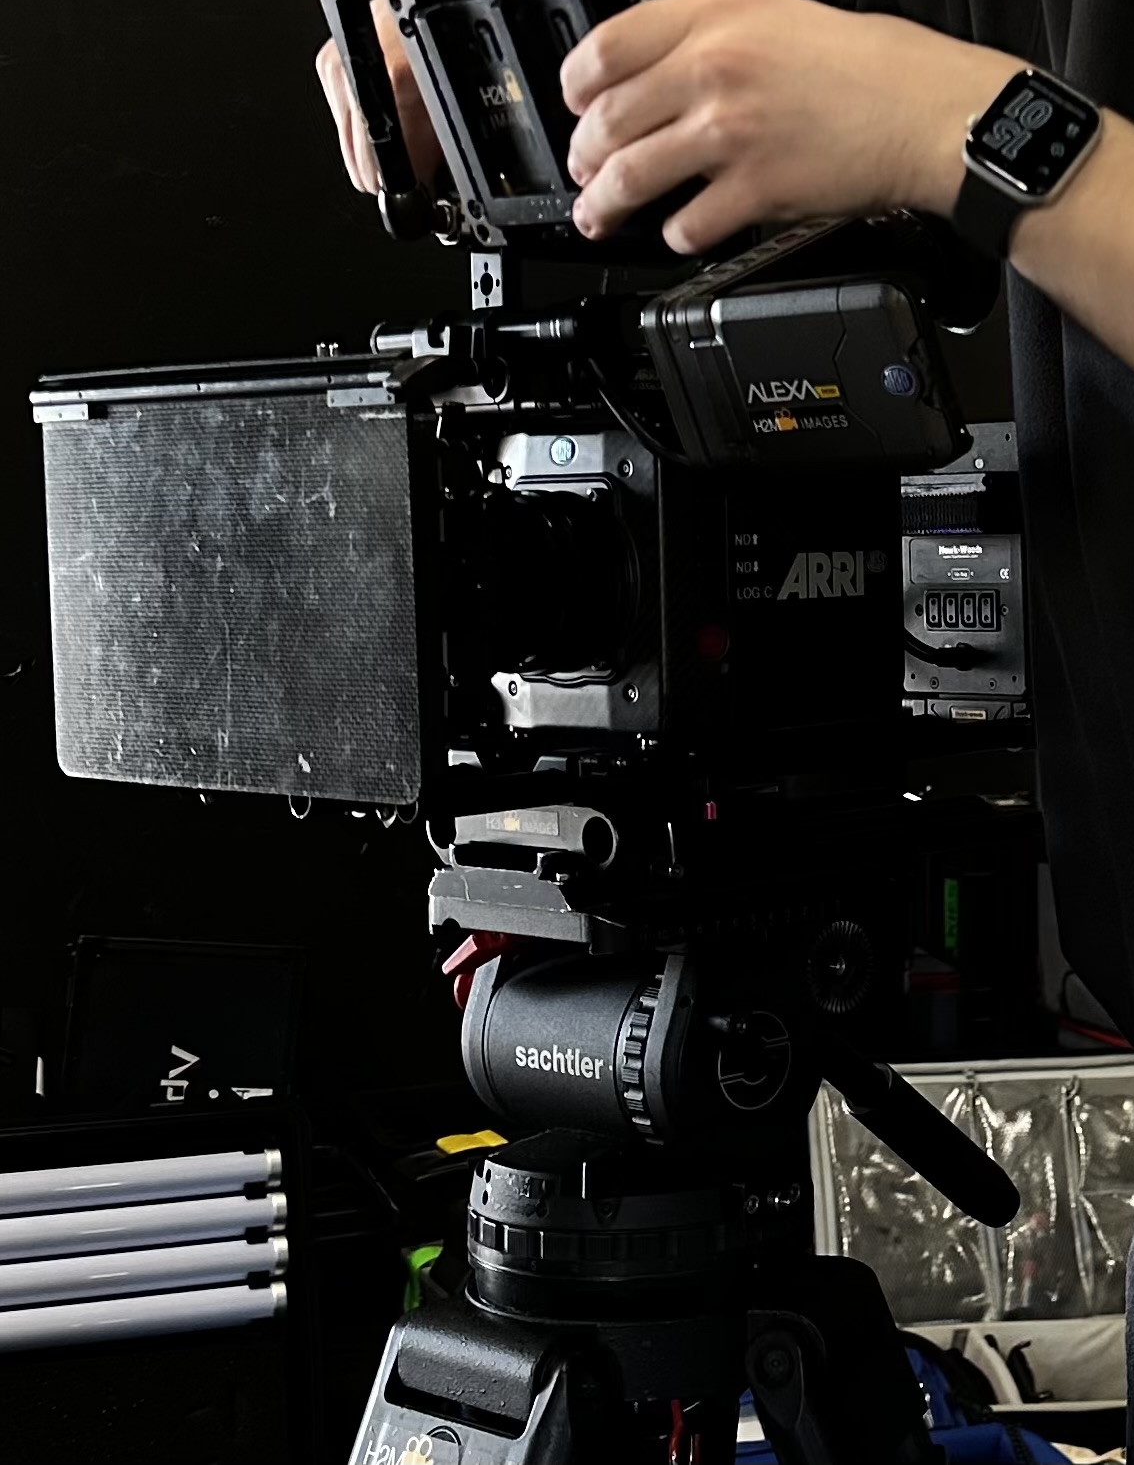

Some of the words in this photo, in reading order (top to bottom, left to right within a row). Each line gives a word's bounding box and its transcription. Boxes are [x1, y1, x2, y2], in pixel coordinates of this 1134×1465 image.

[748, 378, 820, 405] ALEXA
[800, 414, 849, 430] IMAGES
[734, 533, 751, 546] ND
[735, 561, 751, 574] ND
[776, 550, 865, 601] ARRI
[515, 1043, 604, 1080] sachtler
